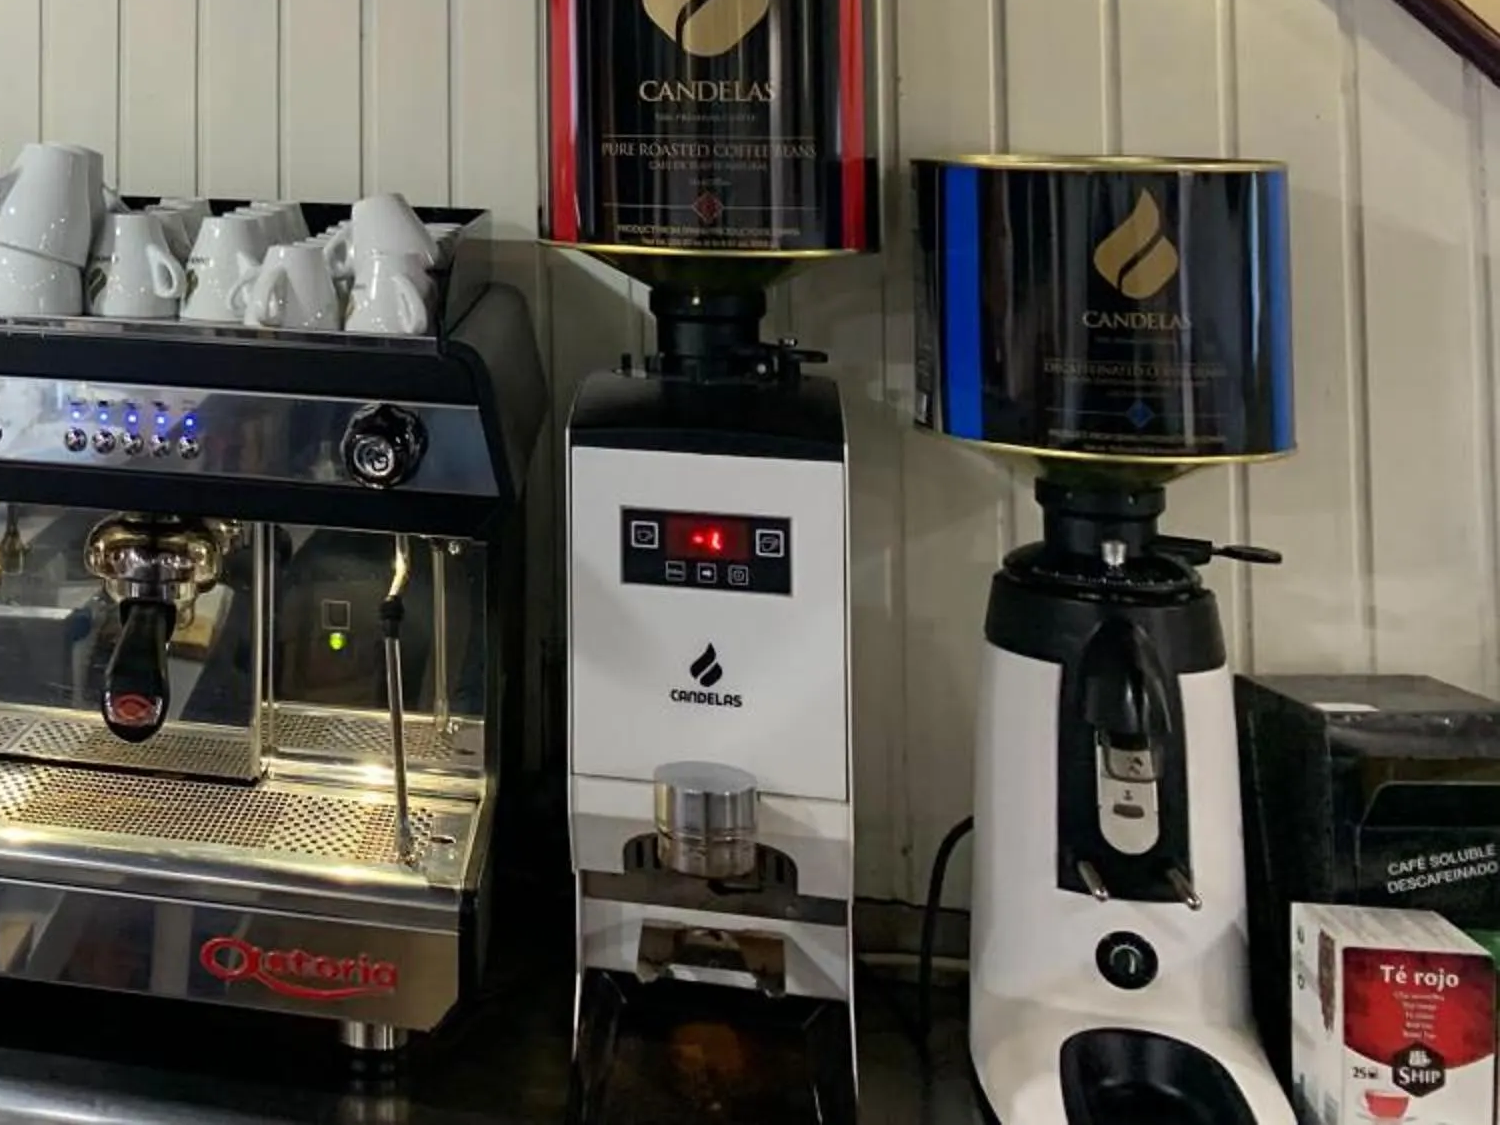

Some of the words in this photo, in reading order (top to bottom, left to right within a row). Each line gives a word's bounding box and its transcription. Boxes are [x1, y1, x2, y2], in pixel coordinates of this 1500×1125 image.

[638, 80, 776, 103] CANDELAS
[601, 141, 637, 158] PURE
[638, 142, 711, 159] ROASTED
[670, 688, 743, 708] CANDELAS
[1429, 842, 1496, 869] SOLUBLE
[1387, 860, 1499, 894] DESCAFEINADO
[1380, 964, 1407, 984] Té
[1414, 968, 1460, 992] rojo
[1398, 1067, 1441, 1085] SHIP
